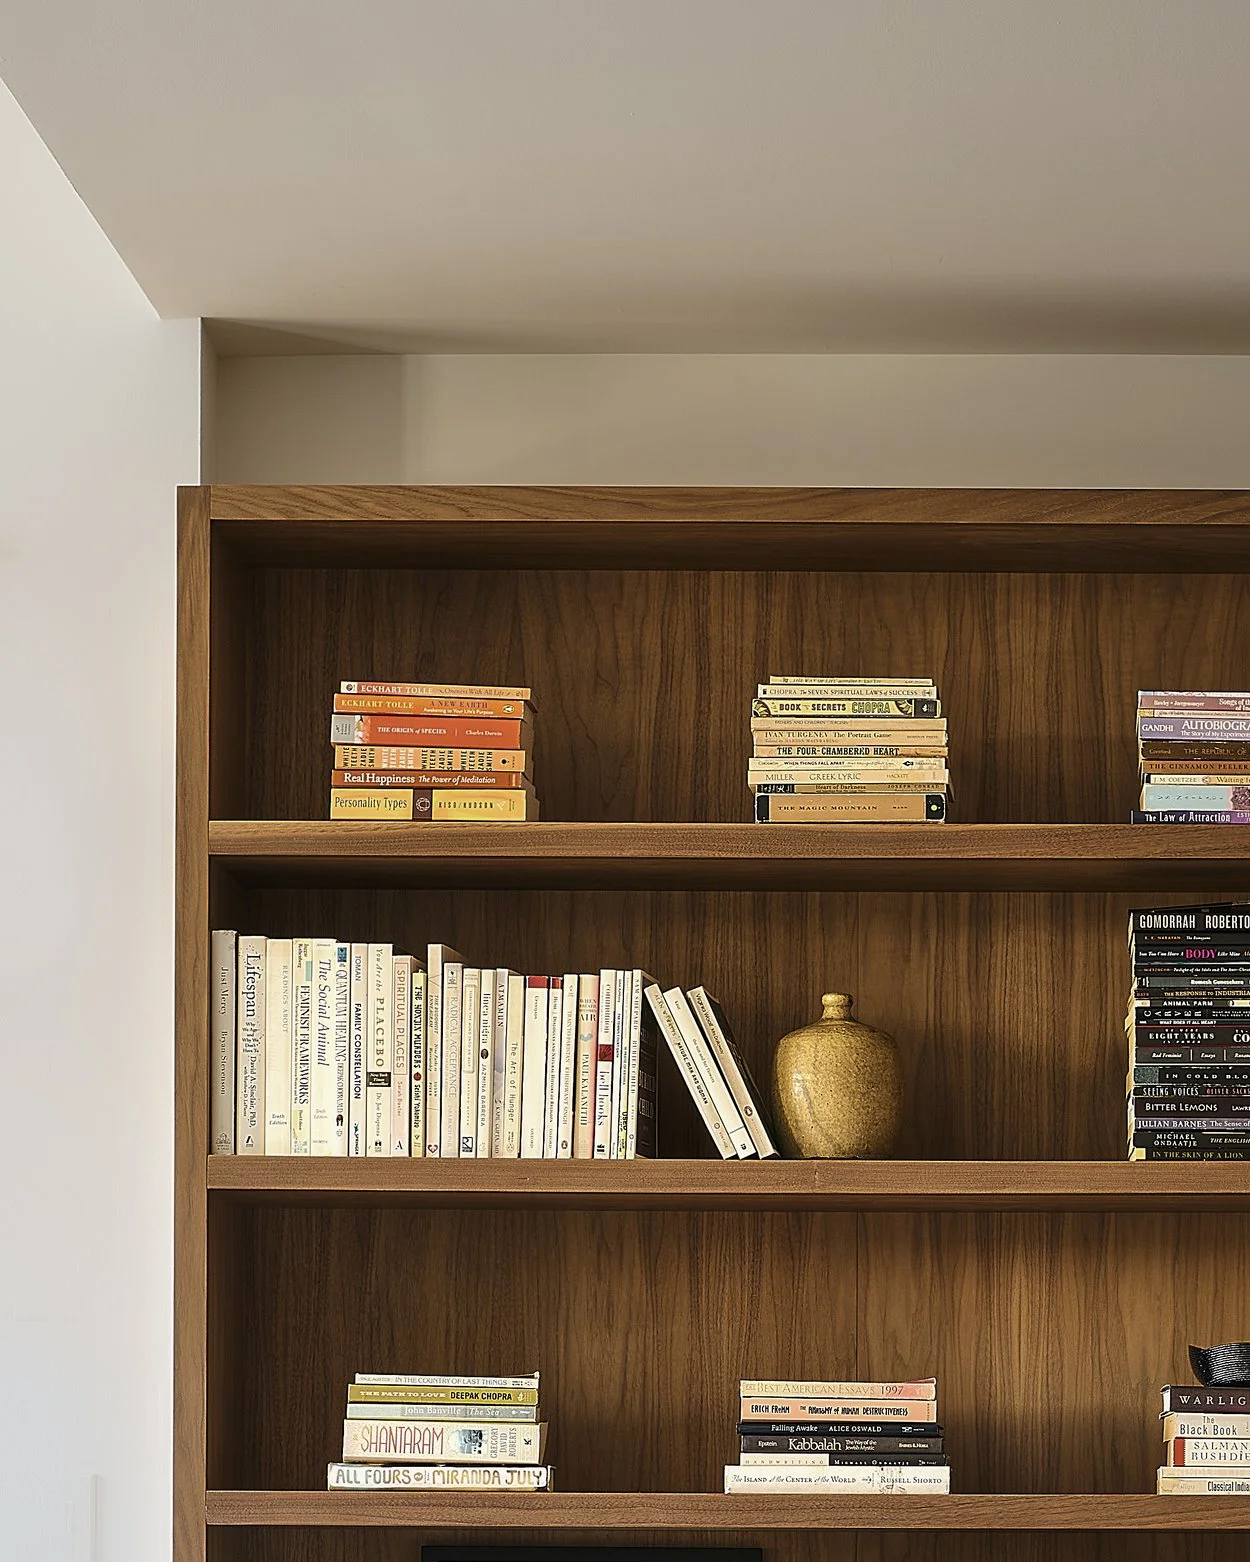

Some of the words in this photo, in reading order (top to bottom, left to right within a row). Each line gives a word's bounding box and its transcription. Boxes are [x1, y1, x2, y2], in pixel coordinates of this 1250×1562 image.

[341, 700, 383, 708] ECKHART
[386, 701, 413, 709] TOLLE
[779, 703, 801, 711] BOOK
[811, 703, 846, 711] SECRETS
[852, 702, 890, 713] CHOPRA
[1142, 724, 1173, 732] GANDHI
[777, 747, 793, 755] THE
[797, 747, 871, 755] FOUR-CHAMBERED
[344, 773, 365, 783] Real
[367, 774, 415, 784] Happiness
[452, 776, 460, 784] of
[461, 776, 496, 784] Meditation
[335, 797, 381, 811] Personality
[384, 798, 407, 808] Types
[1145, 814, 1156, 822] The
[1159, 812, 1176, 822] Law
[1179, 814, 1185, 822] of
[1188, 812, 1230, 822] Attraction
[1139, 915, 1195, 929] GOMORRAH
[1206, 915, 1250, 928] ROBERTO
[1186, 949, 1216, 958] BODY
[220, 966, 229, 986] Just
[318, 959, 331, 981] The
[242, 954, 261, 1017] Lifespan
[335, 969, 347, 1017] QUANTUM
[218, 990, 228, 1015] Mercy
[318, 984, 331, 1019] Social
[396, 970, 405, 1024] SPIRITUAL
[497, 983, 505, 1027] ATMAMUN
[299, 985, 310, 1031] FEMINIST
[354, 1003, 362, 1031] FAMILY
[218, 1031, 228, 1053] Bryan
[335, 1020, 347, 1062] HEALING
[376, 998, 385, 1067] PLACEBO
[317, 1022, 330, 1067] Animal
[396, 1028, 405, 1068] PLACES
[510, 1043, 518, 1056] The
[299, 1033, 310, 1104] FRAMEWORKS
[354, 1034, 362, 1099] CONSTELLATION
[509, 1061, 518, 1076] Art
[581, 1054, 590, 1075] PAUL
[220, 1056, 228, 1095] Stevenson
[509, 1080, 516, 1090] of
[598, 1071, 609, 1091] bell
[508, 1094, 516, 1122] Hunger
[580, 1078, 589, 1125] KALANITHI
[597, 1094, 608, 1126] hooks
[1146, 1103, 1176, 1111] BITTER
[1180, 1103, 1217, 1112] LEMONS
[450, 1391, 479, 1399] DEEPAK
[481, 1392, 512, 1400] CHOPRA
[1180, 1424, 1208, 1435] Black
[1213, 1425, 1237, 1436] Book
[1203, 1416, 1214, 1424] The
[361, 1426, 444, 1455] SHANTARAM
[788, 1438, 841, 1451] Kabbalah
[336, 1469, 360, 1484] ALL
[365, 1470, 411, 1484] FOURS
[433, 1470, 501, 1484] MIRANDA
[505, 1470, 542, 1485] JULY
[1208, 1481, 1234, 1491] Classical
